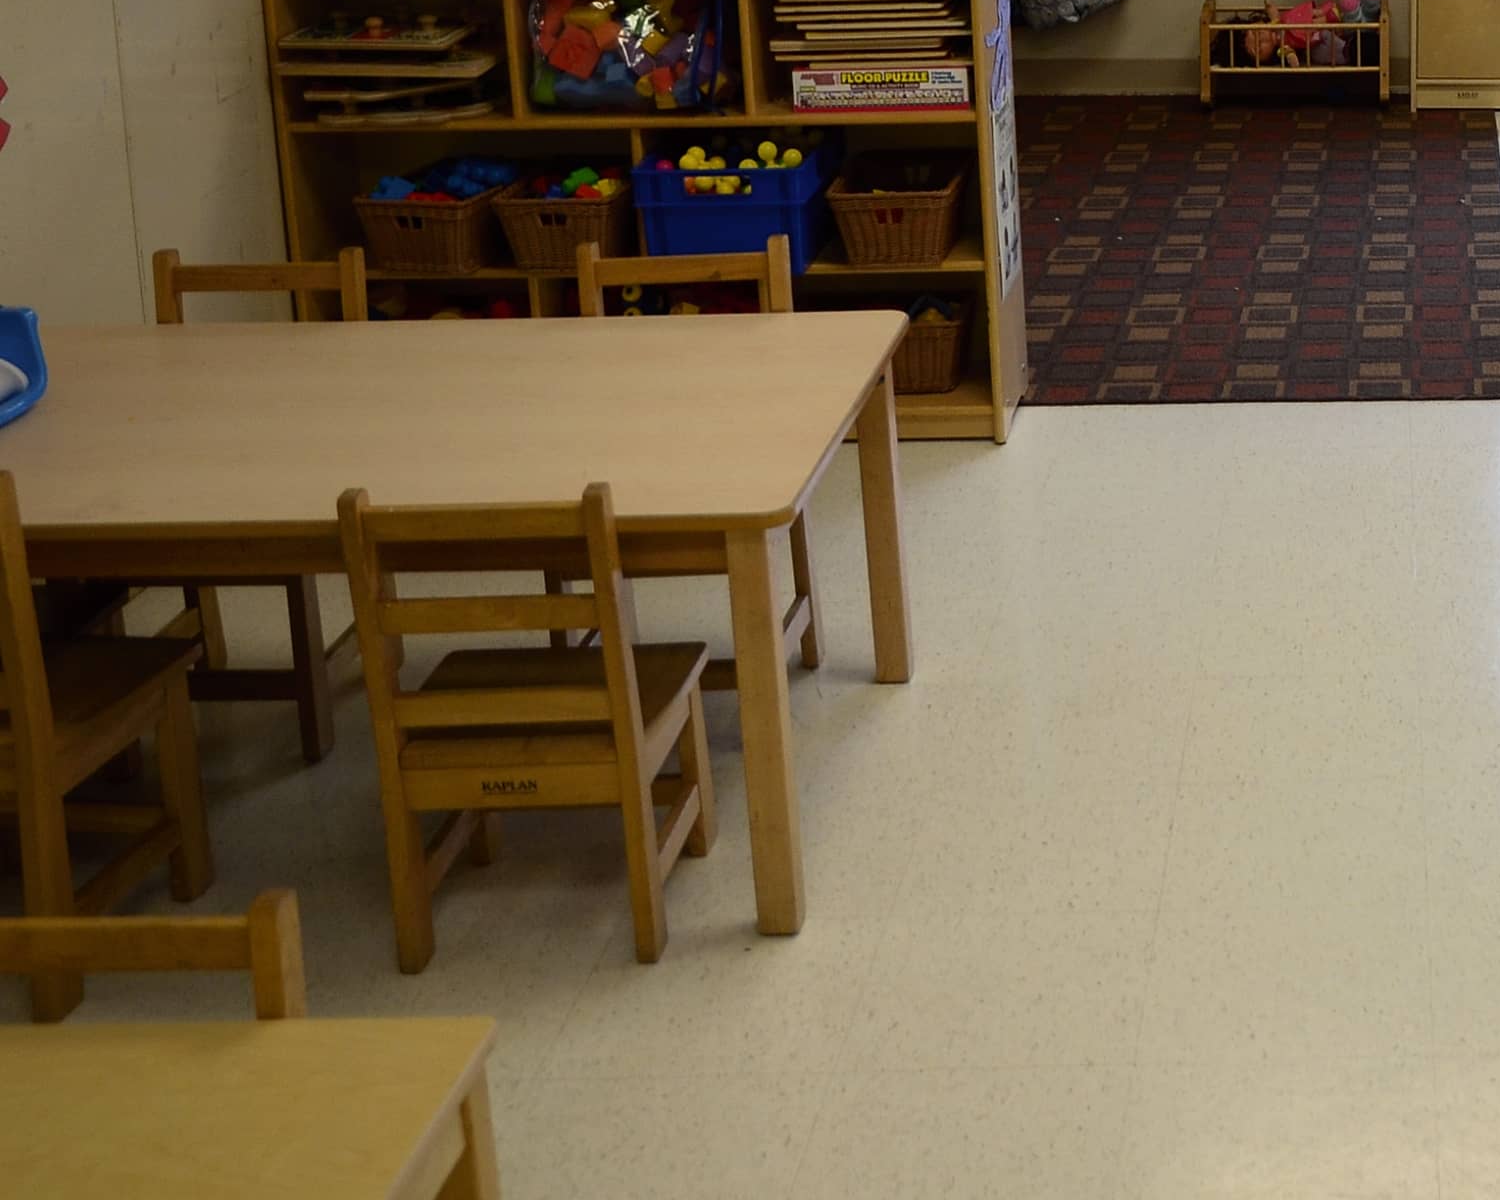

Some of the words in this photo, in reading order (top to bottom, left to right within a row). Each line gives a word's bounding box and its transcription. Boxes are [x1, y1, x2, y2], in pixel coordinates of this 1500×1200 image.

[840, 71, 883, 84] FLOOR
[884, 70, 930, 84] PUZZLE
[481, 779, 538, 793] KAPLAN
